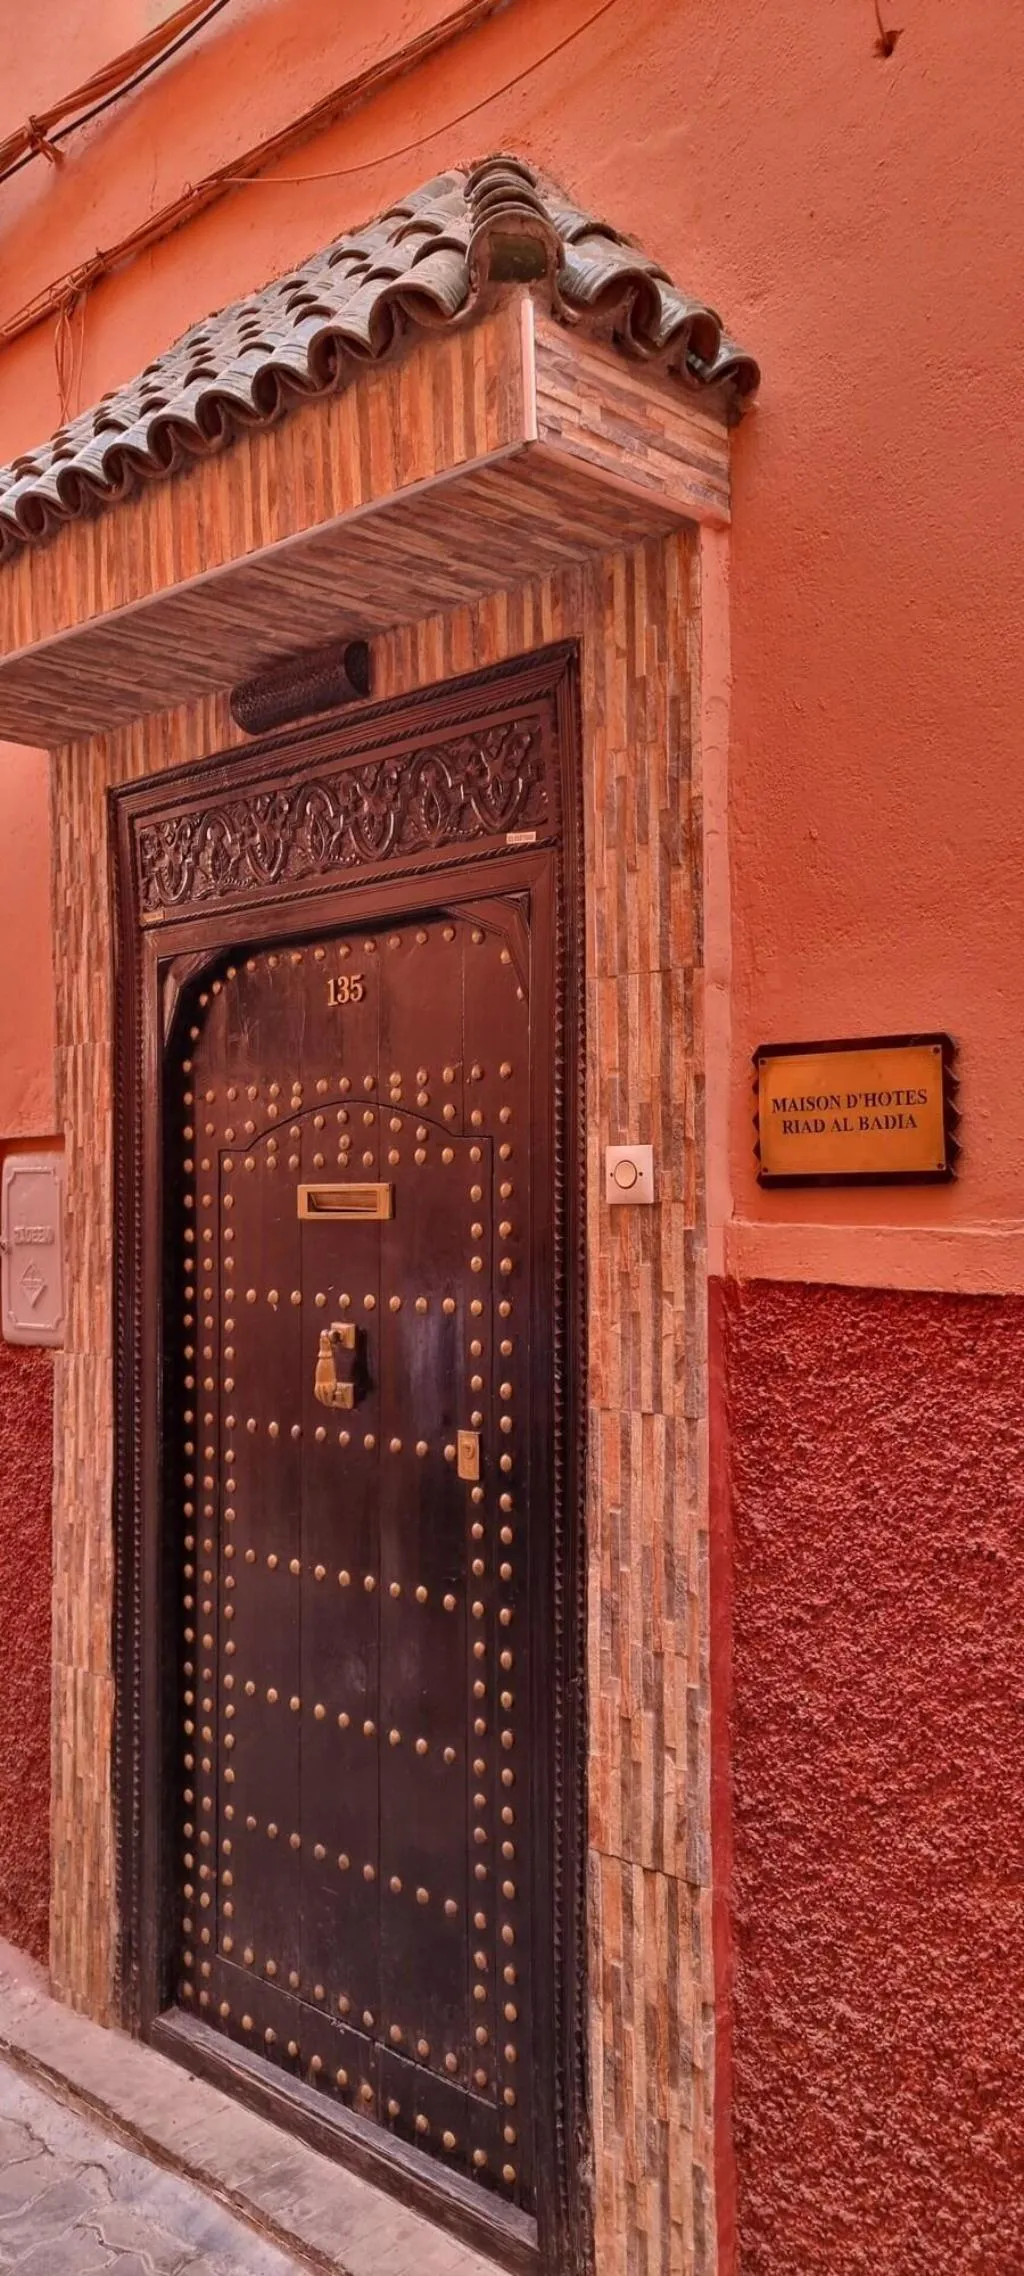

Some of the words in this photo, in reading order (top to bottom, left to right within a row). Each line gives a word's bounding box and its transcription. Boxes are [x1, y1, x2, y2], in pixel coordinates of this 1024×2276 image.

[327, 974, 363, 1006] 135
[772, 1094, 841, 1113] MAISON
[846, 1089, 928, 1109] D'HOTES
[782, 1118, 826, 1135] RIAD
[831, 1116, 854, 1132] AL
[859, 1113, 918, 1130] BADIA
